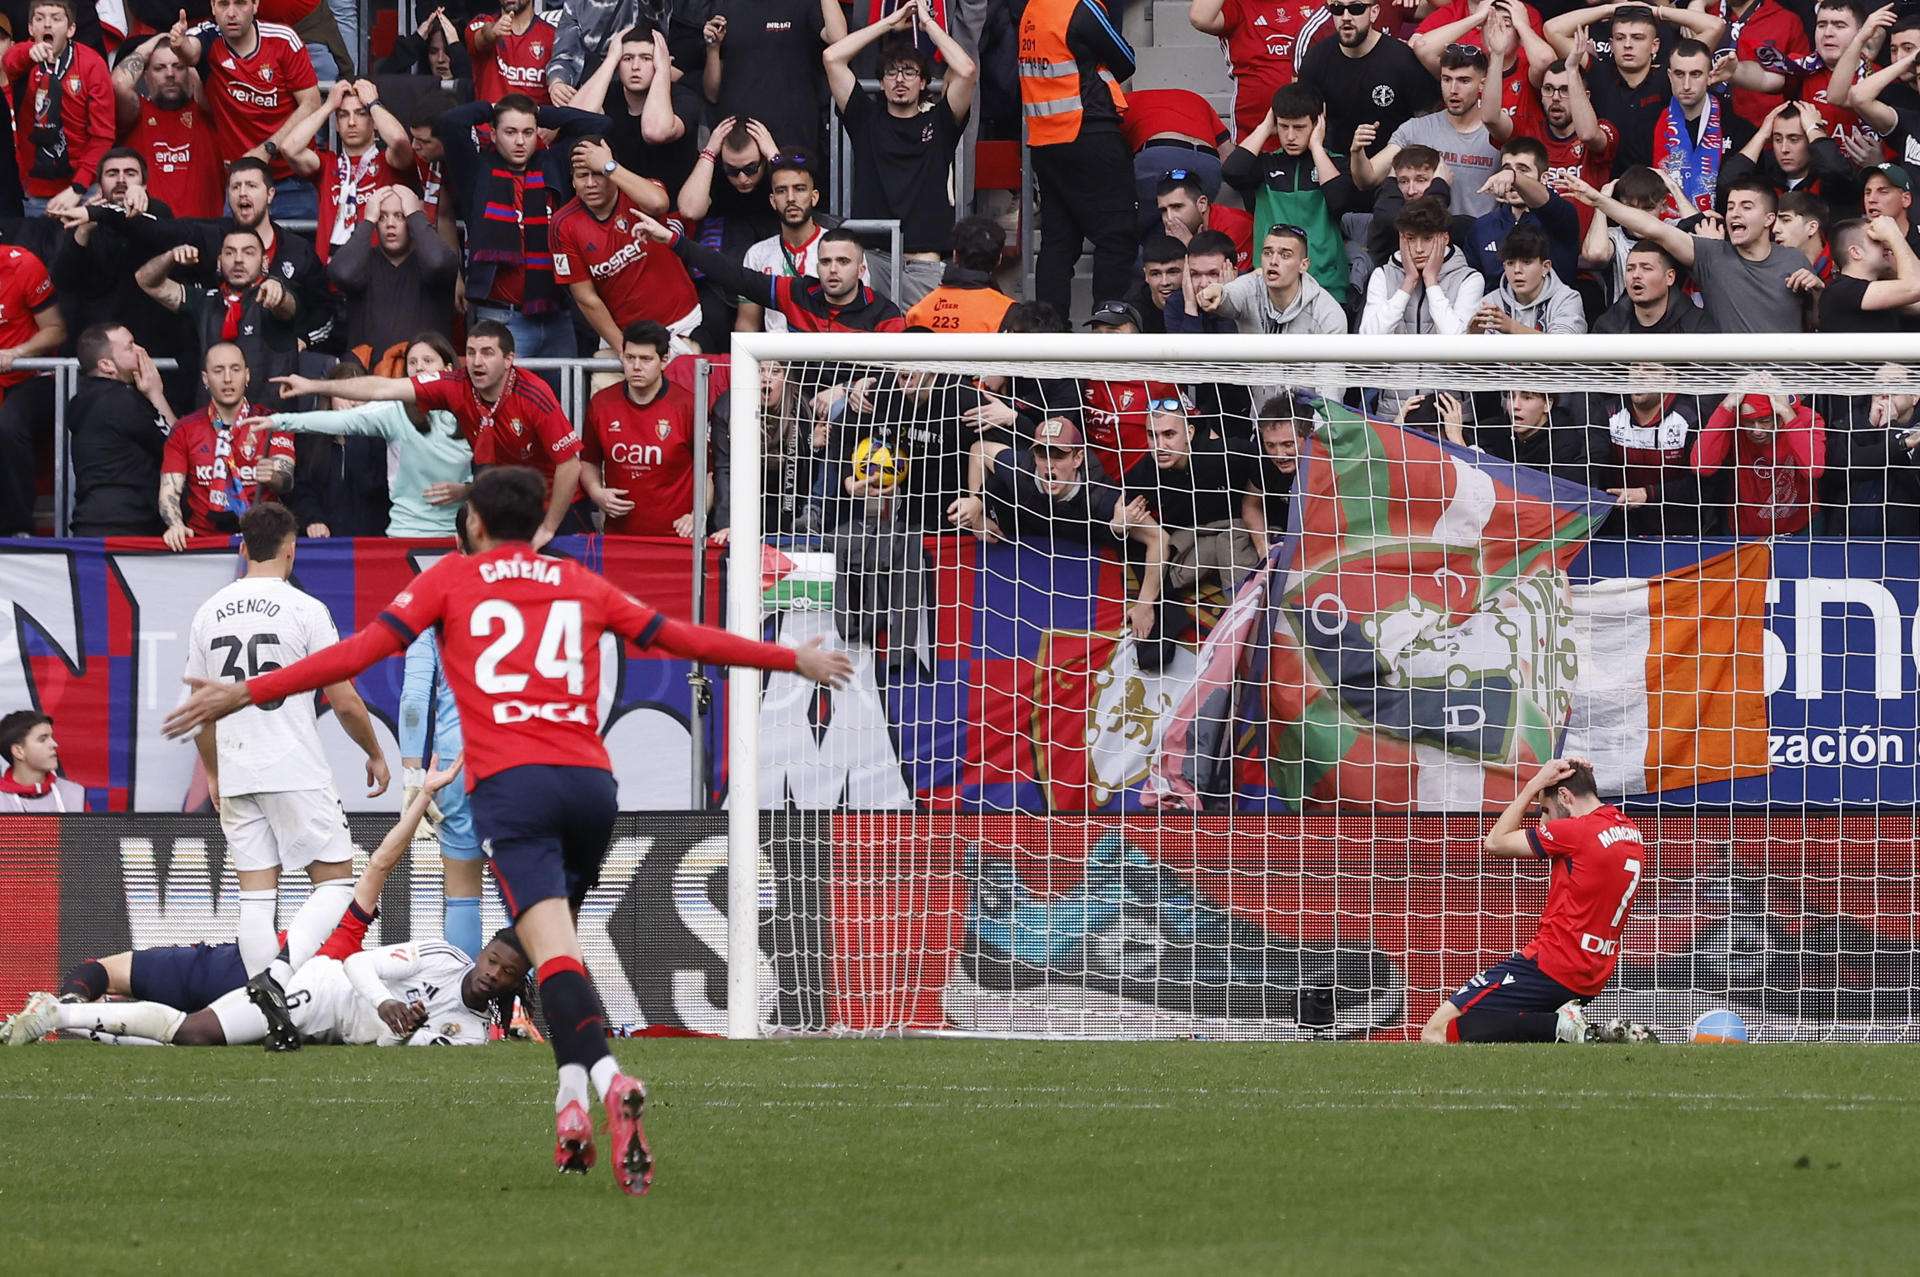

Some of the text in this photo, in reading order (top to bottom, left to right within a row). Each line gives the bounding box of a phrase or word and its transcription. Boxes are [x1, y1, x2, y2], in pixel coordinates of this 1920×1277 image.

[1022, 38, 1036, 52] 201
[1266, 42, 1292, 56] ver
[931, 315, 960, 329] 223
[611, 442, 662, 465] can
[479, 559, 561, 586] CATENA
[215, 599, 281, 622] ASENCIO
[470, 599, 584, 696] 24
[1610, 858, 1641, 928] 7
